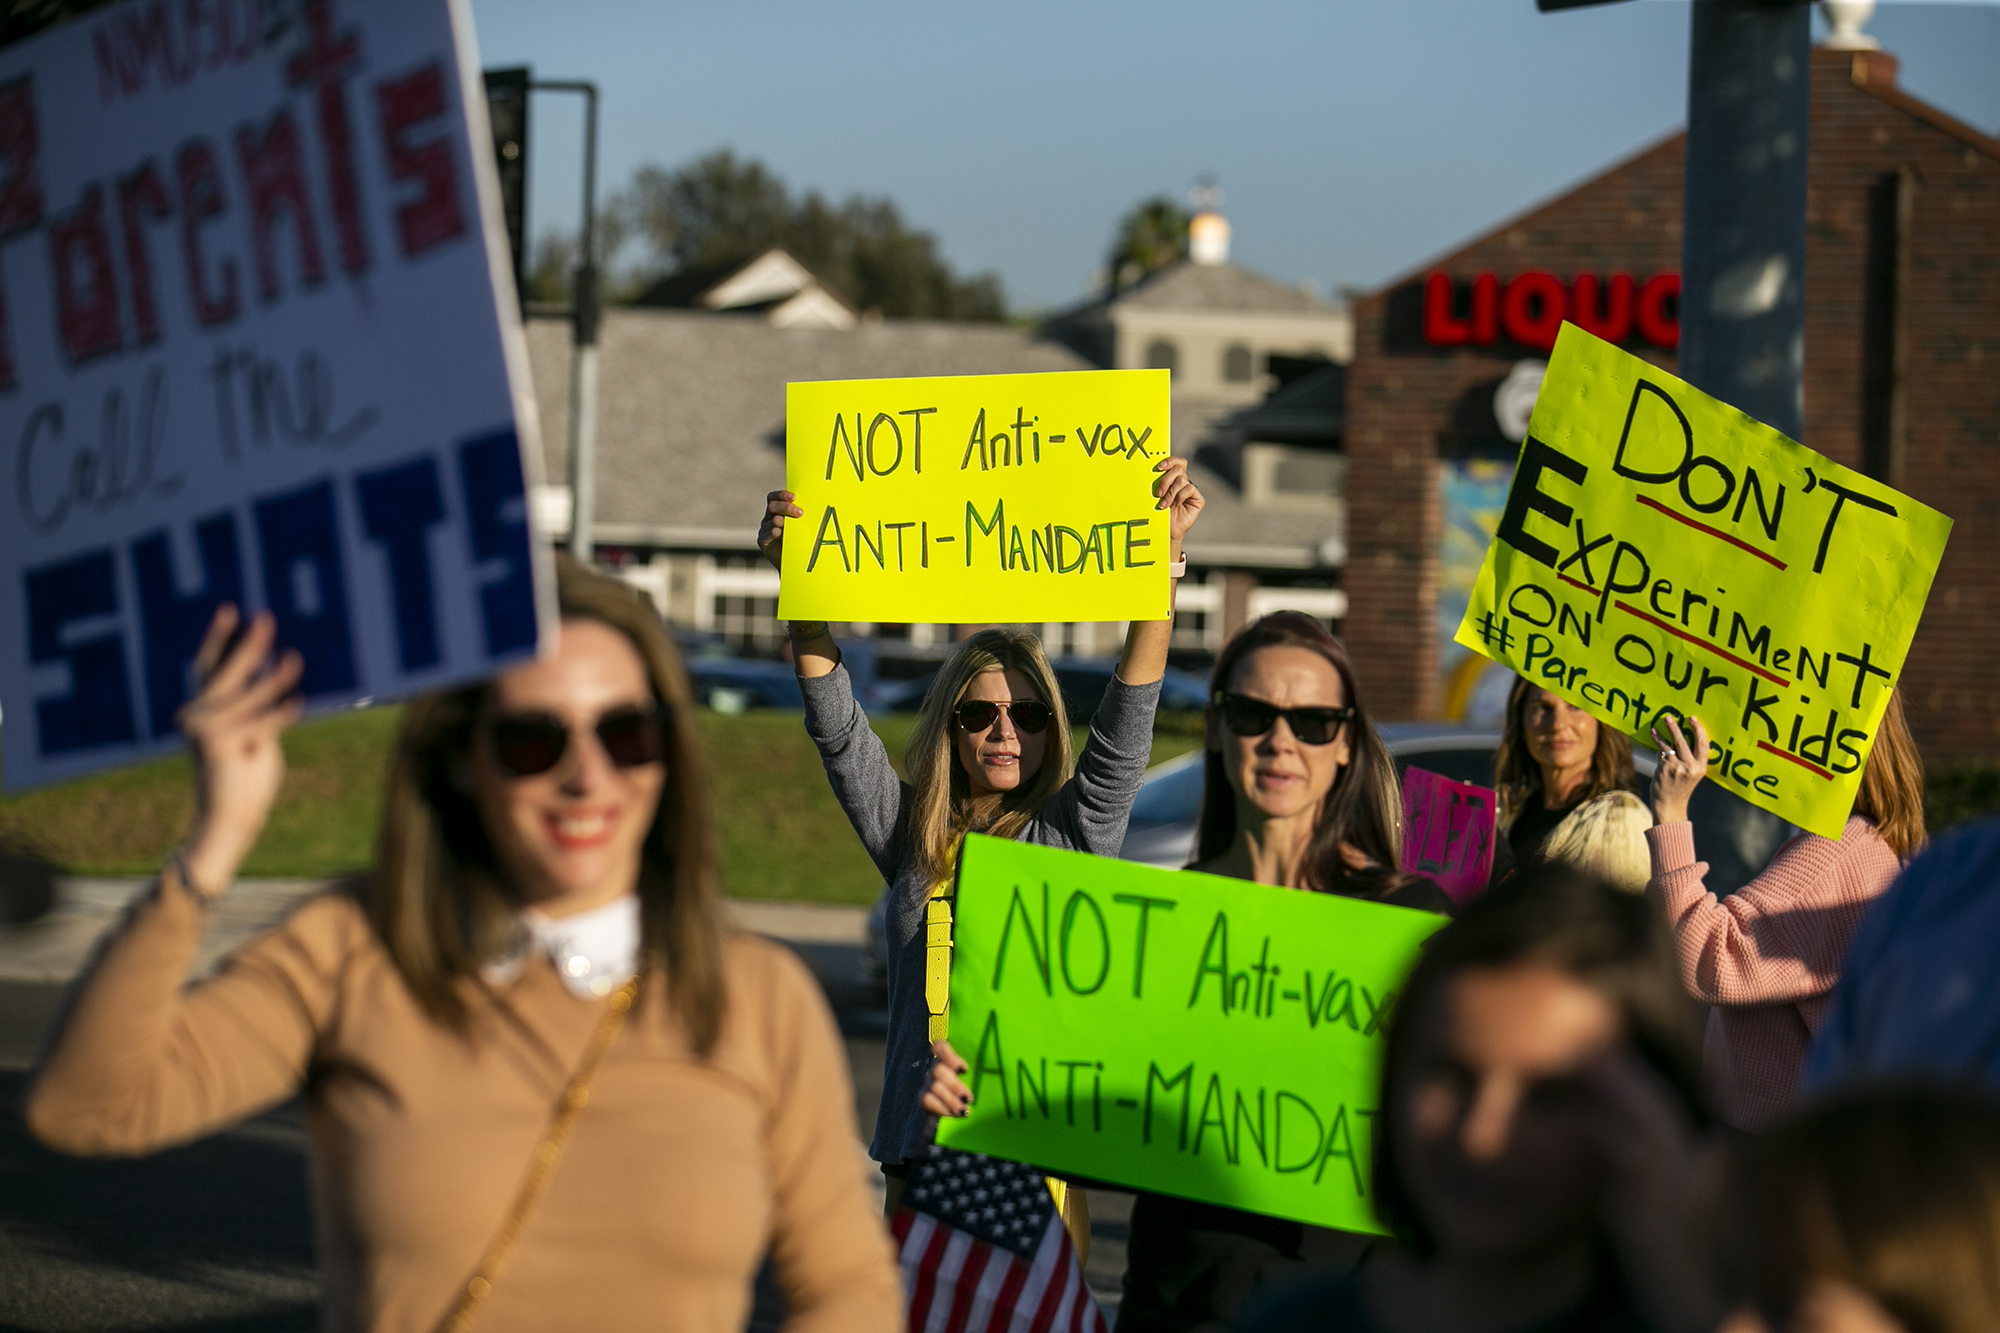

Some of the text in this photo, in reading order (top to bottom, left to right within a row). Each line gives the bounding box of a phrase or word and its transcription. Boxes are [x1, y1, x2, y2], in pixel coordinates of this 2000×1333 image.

[825, 406, 937, 482] NOT
[1612, 378, 1898, 574] DON'T
[26, 432, 537, 756] SHOTS
[1508, 583, 1591, 648] ON
[992, 881, 1177, 999] NOT
